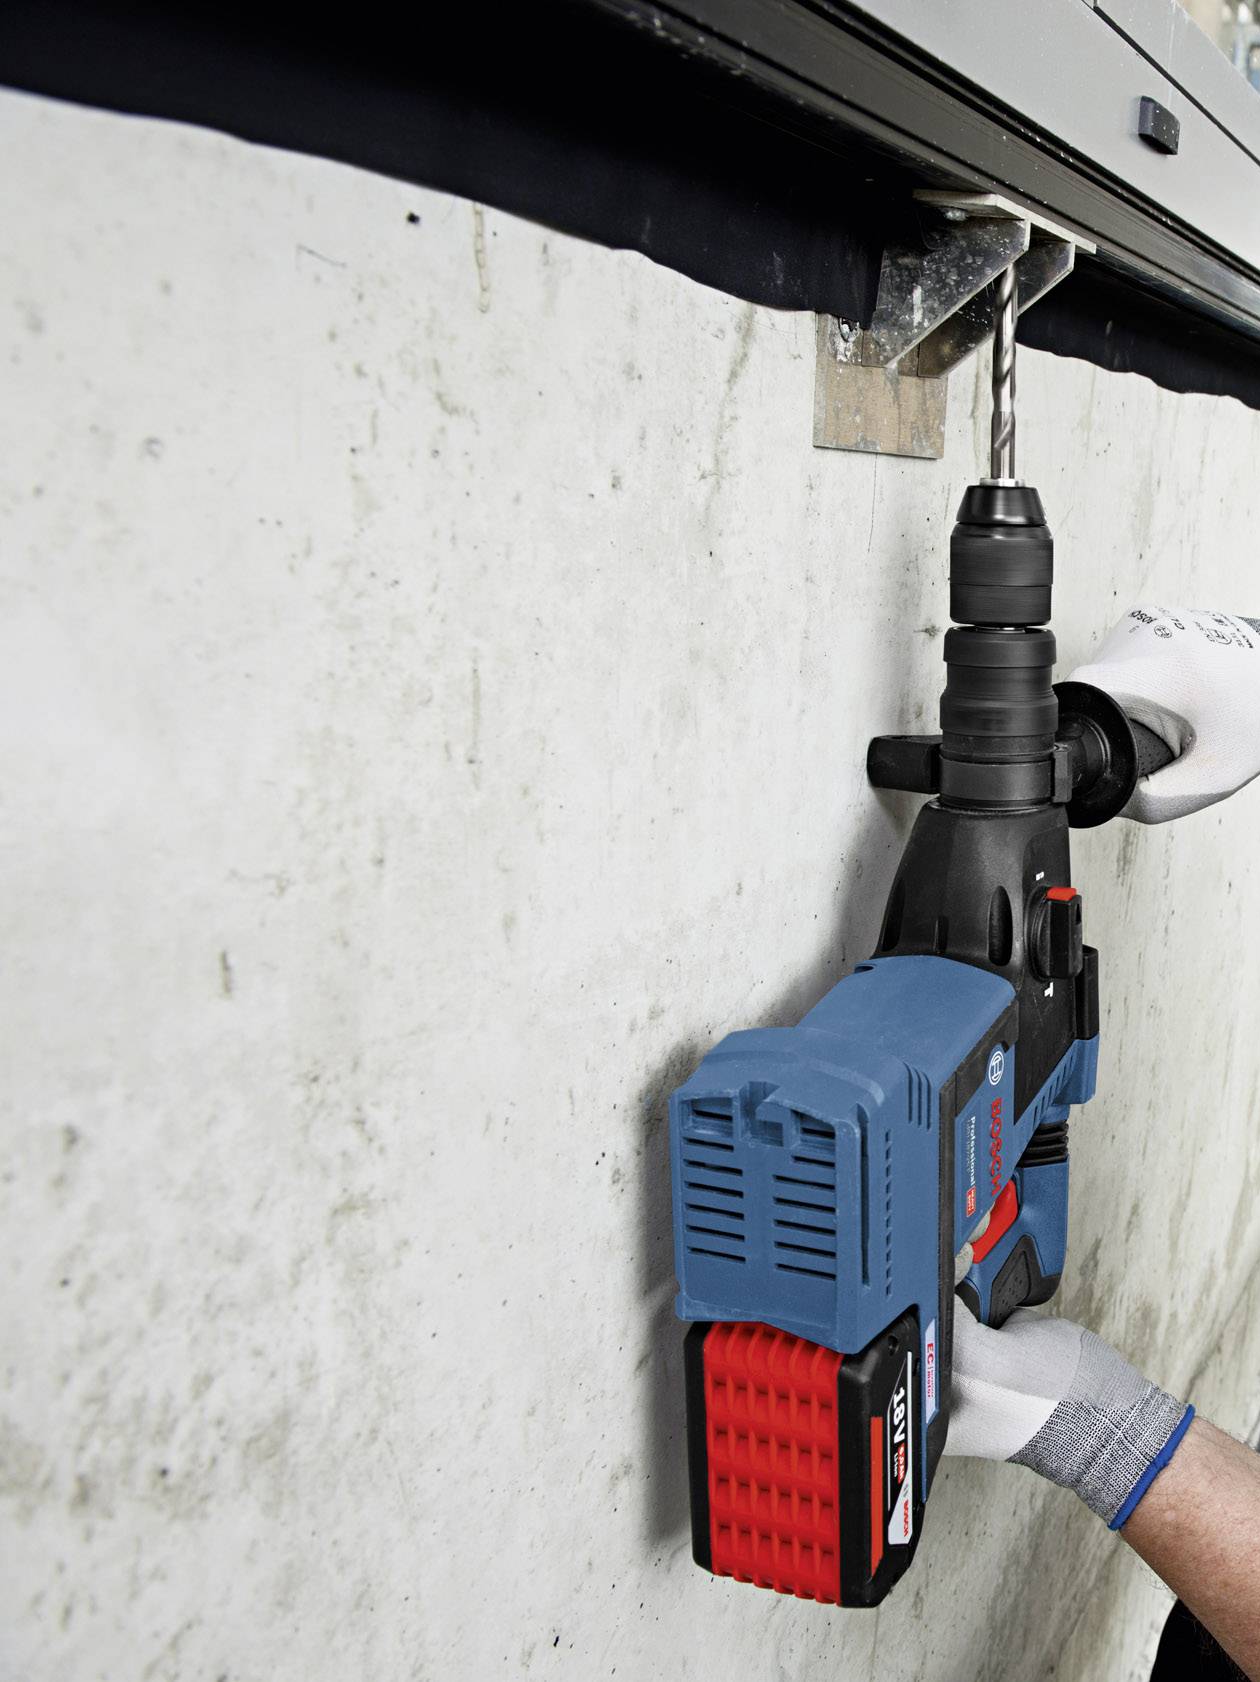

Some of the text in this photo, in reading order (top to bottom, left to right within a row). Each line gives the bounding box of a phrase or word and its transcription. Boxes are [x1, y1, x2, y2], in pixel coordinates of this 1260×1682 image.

[992, 1098, 1002, 1195] BOSCH
[927, 1343, 934, 1365] EC
[894, 1387, 905, 1444] 18V
